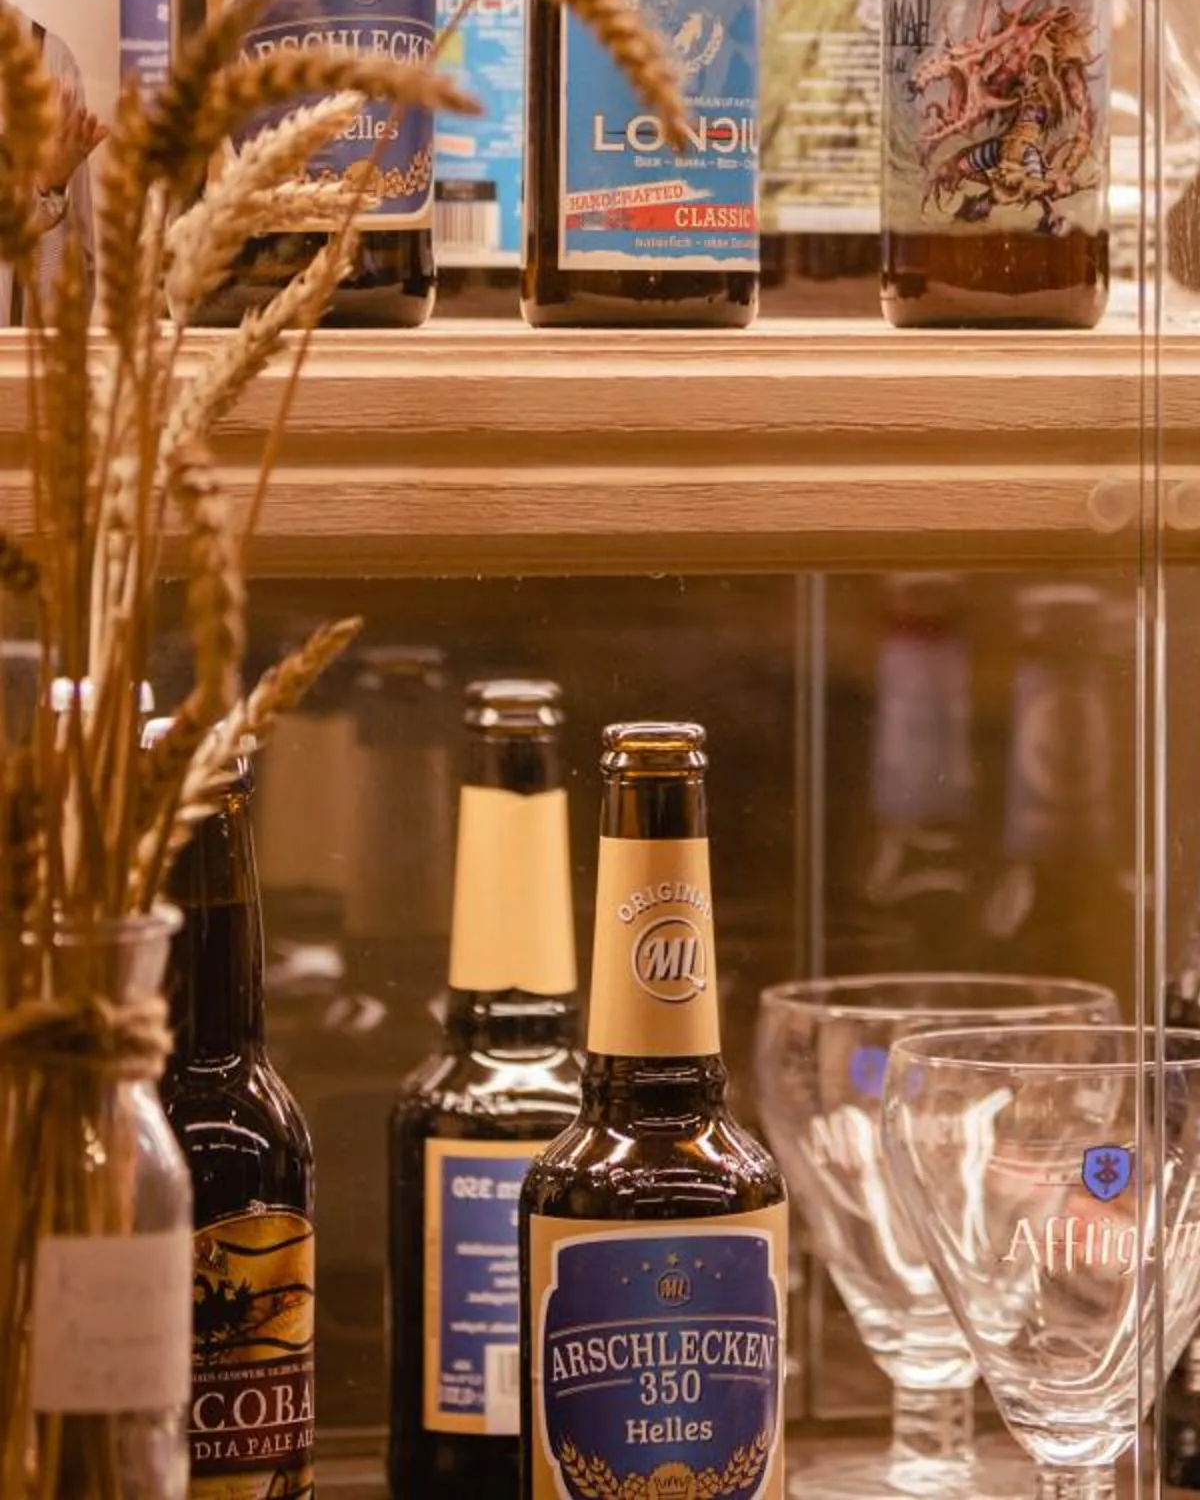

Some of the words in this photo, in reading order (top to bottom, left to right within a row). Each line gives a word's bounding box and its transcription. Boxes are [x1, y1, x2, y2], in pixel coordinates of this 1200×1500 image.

[333, 114, 400, 142] elles
[569, 184, 683, 212] HANDCRAFTED
[674, 206, 752, 230] CLASSIC
[552, 1330, 775, 1382] ARSCHLECKEN
[640, 1369, 702, 1406] 350
[625, 1416, 713, 1444] Helles
[246, 1434, 293, 1455] PALE
